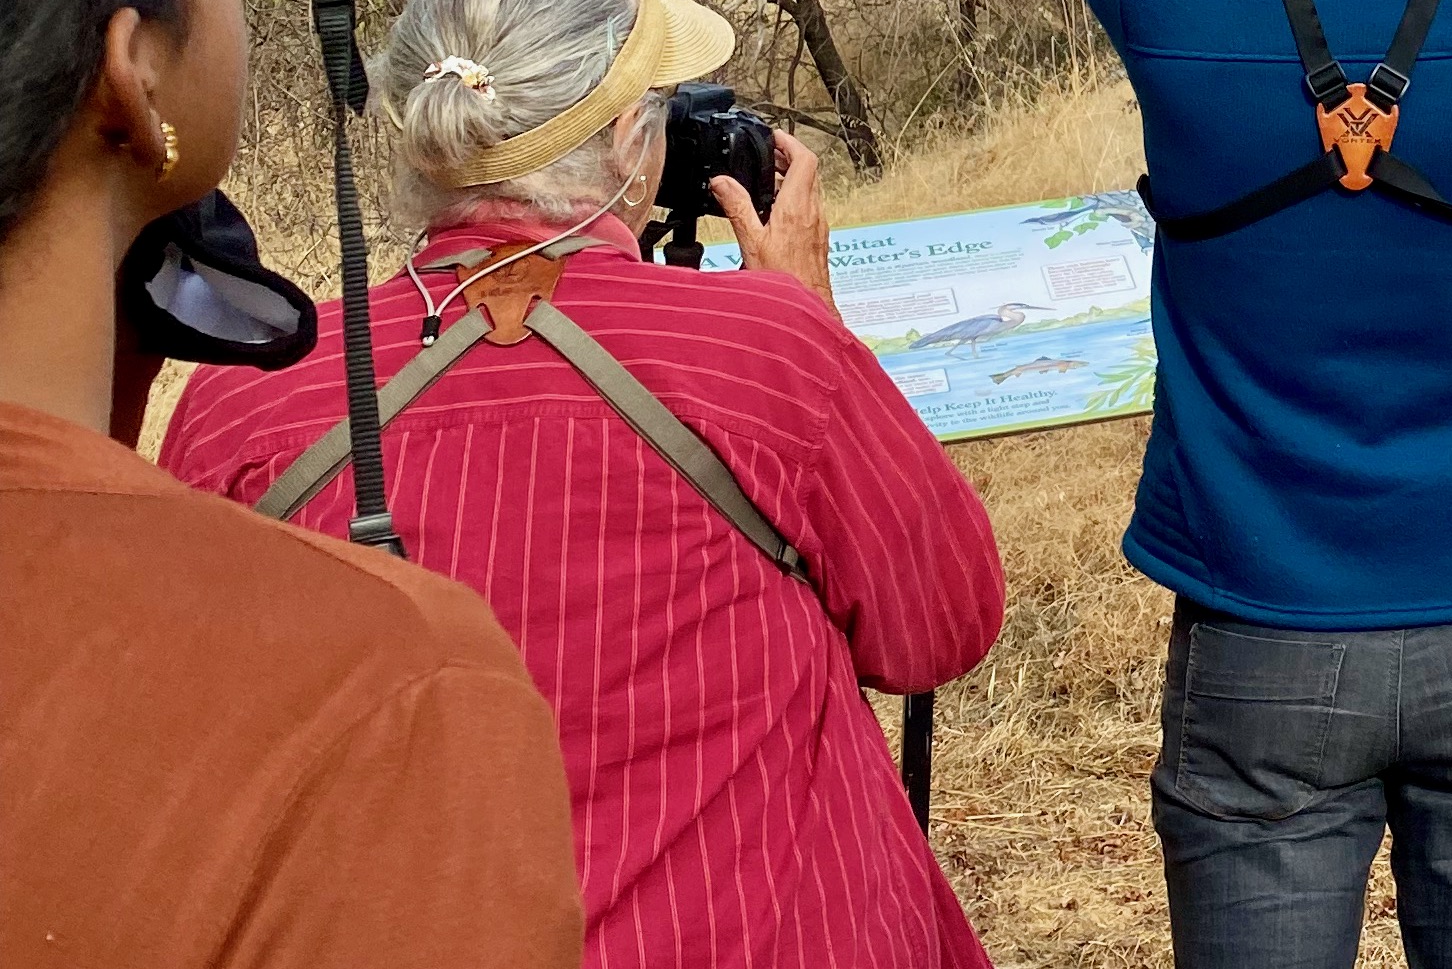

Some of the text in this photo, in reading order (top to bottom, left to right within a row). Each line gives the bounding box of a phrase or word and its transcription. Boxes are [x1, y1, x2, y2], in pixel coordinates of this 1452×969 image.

[828, 240, 993, 268] Water's Edge
[944, 401, 982, 411] Keep
[1000, 390, 1058, 403] Healthy.
